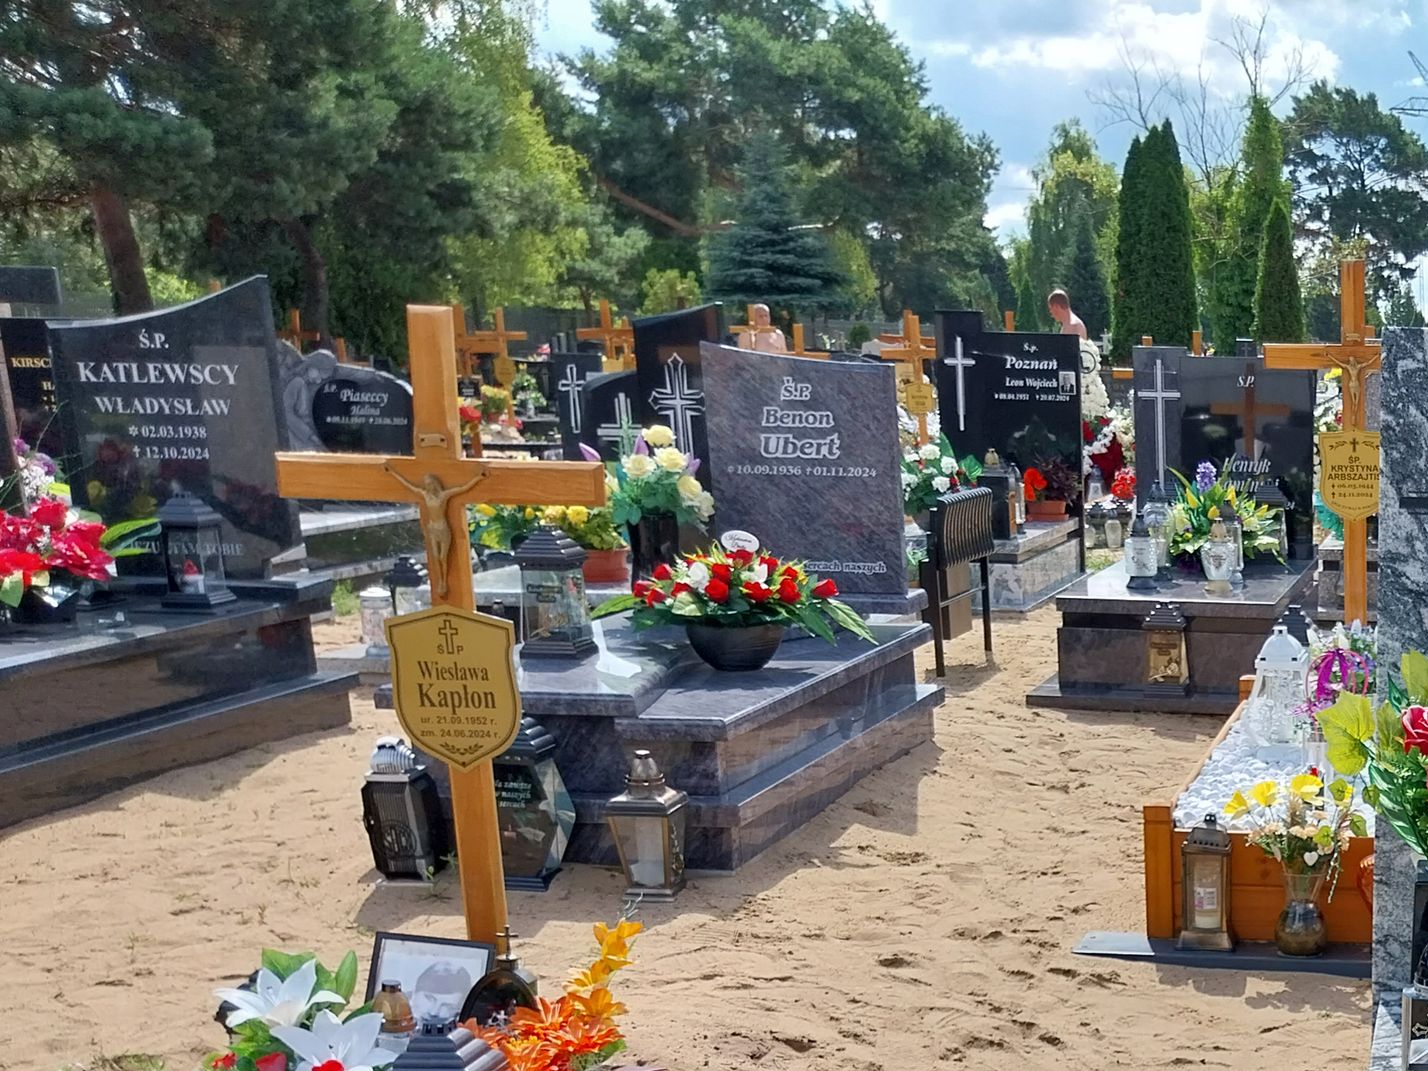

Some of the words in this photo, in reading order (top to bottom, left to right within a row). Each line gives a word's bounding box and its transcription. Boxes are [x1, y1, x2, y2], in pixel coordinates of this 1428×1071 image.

[139, 328, 169, 349] Ś.P.
[11, 356, 53, 369] KIRSC
[1005, 355, 1058, 370] Poznań
[76, 361, 239, 385] KATLEWSCY
[94, 396, 231, 416] WŁADYSŁAW
[761, 406, 835, 428] Benon
[141, 426, 207, 440] 02.03.1938
[146, 446, 210, 460] 12.10.2024
[760, 433, 841, 460] Ubert
[813, 467, 878, 478] 01.11.2024
[1330, 464, 1379, 473] KRYSTYNA
[417, 661, 489, 682] Wiesława
[417, 683, 497, 715] Kapłon
[436, 715, 487, 726] 21.09.1952
